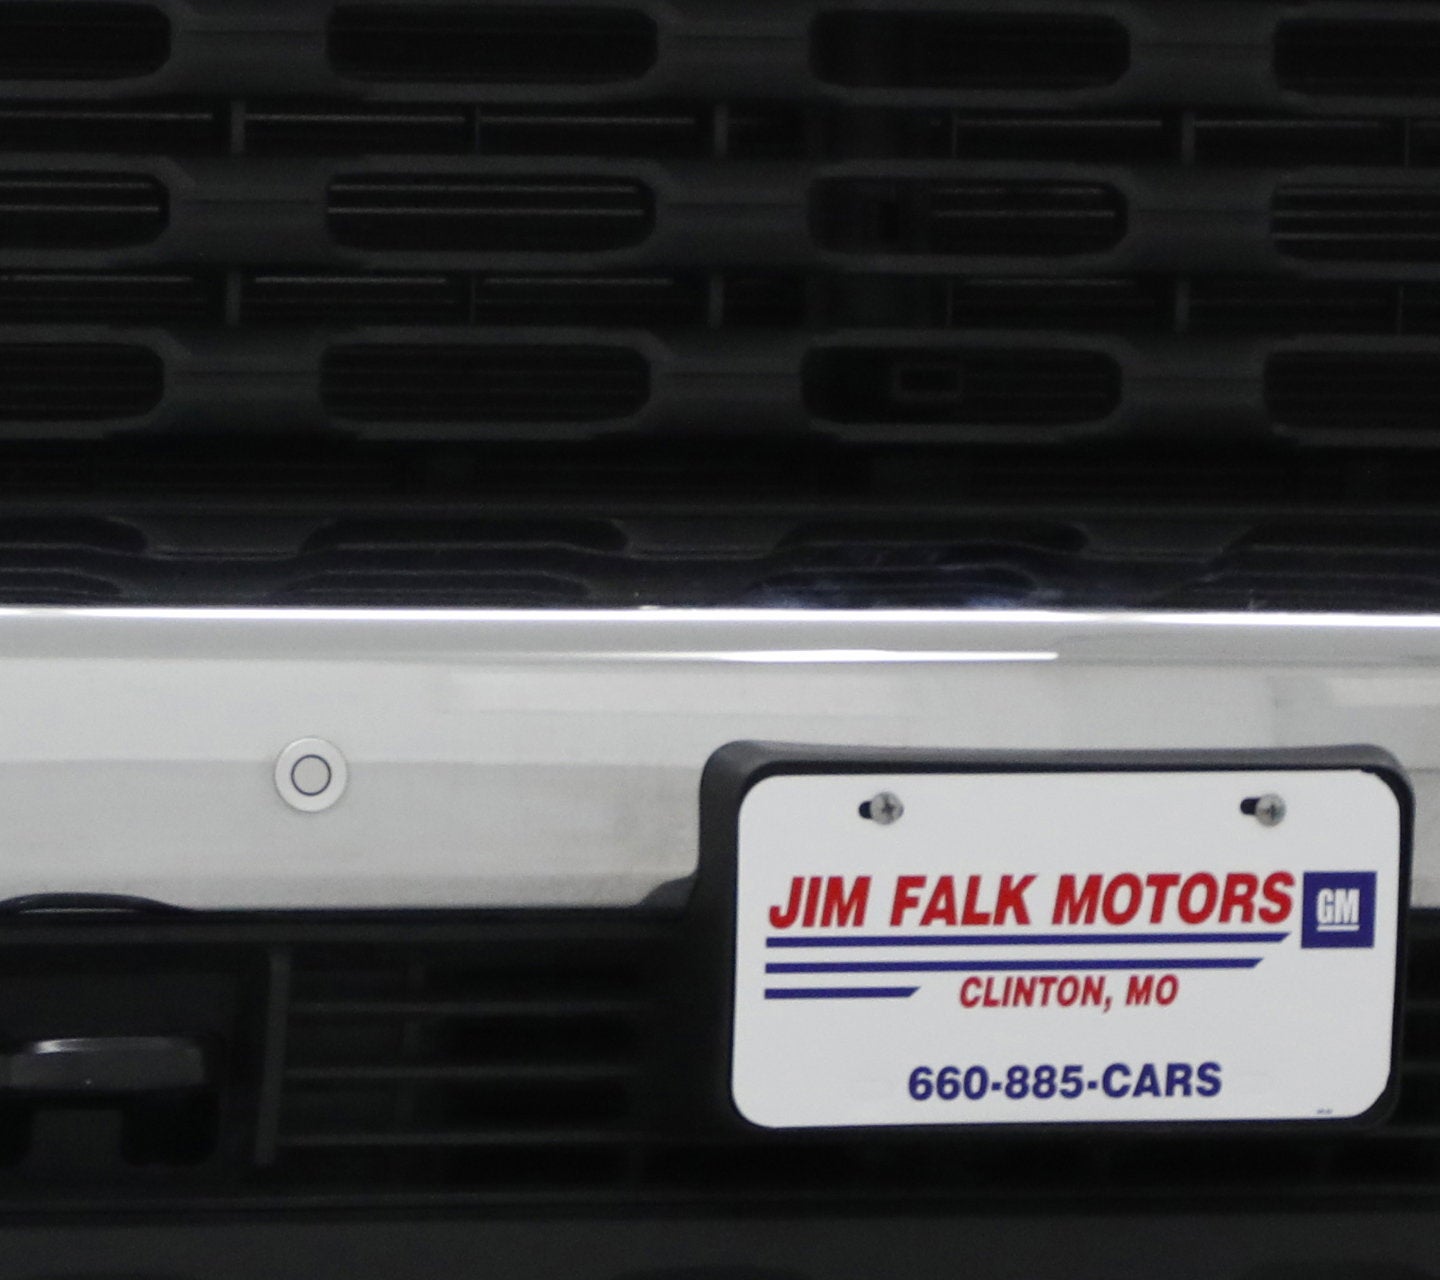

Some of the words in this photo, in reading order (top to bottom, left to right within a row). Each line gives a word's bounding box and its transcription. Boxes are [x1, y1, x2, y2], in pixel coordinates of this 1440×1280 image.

[769, 875, 871, 929] JIM
[889, 874, 1036, 927] FALK
[1051, 871, 1295, 926] MOTORS
[1316, 887, 1360, 924] GM
[959, 975, 1111, 1011] CLINTON,
[1125, 974, 1179, 1006] MO
[908, 1061, 1222, 1101] 660-885-CARS
